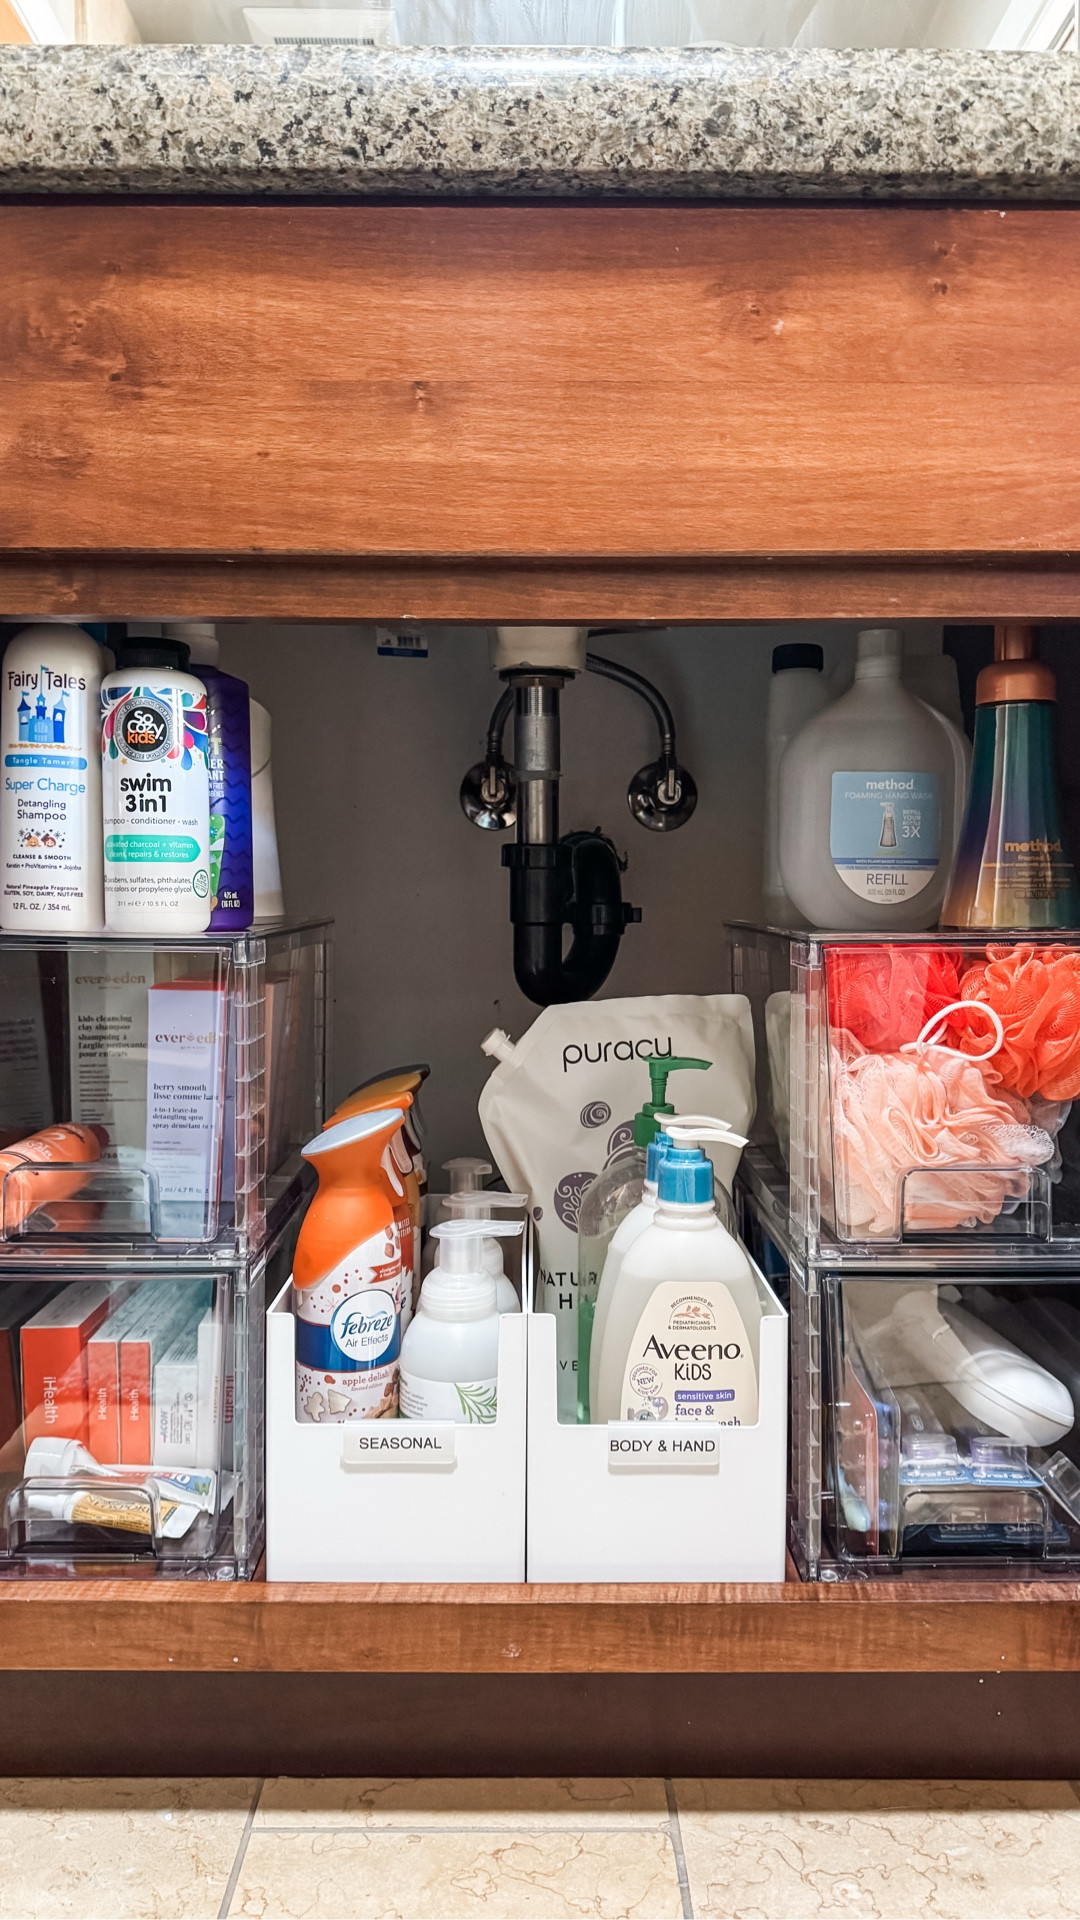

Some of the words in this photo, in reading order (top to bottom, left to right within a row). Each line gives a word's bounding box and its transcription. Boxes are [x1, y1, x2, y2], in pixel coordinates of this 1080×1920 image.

[7, 671, 38, 691] Fairy
[45, 671, 87, 691] Tales
[127, 728, 156, 744] kids
[12, 757, 38, 765] Tangle
[5, 777, 34, 795] Super
[37, 778, 86, 796] Charge
[120, 772, 172, 792] swim
[865, 778, 914, 790] method
[844, 791, 883, 800] FOAMING
[885, 791, 909, 800] HAND
[17, 798, 67, 810] Detangling
[16, 809, 67, 822] Shampoo
[130, 816, 176, 825] conditioner
[182, 818, 199, 826] wash
[902, 825, 921, 838] 3X
[130, 840, 160, 848] charcoal
[169, 841, 194, 849] vitamin
[128, 850, 153, 859] repairs
[160, 851, 189, 859] restores
[63, 864, 82, 872] Jojoba
[129, 875, 156, 884] sulfates,
[866, 873, 909, 886] REFILL
[22, 884, 49, 892] Pineapple
[138, 885, 173, 894] propylene
[174, 886, 192, 895] glycol
[12, 902, 20, 910] 12
[47, 903, 60, 911] 354
[61, 904, 71, 912] mL
[153, 1083, 175, 1092] berry
[177, 1083, 207, 1092] smooth
[152, 1113, 187, 1121] detangling
[670, 1295, 708, 1309] RECOMMENDED
[706, 1301, 714, 1309] BY
[340, 1312, 394, 1340] febreze
[345, 1338, 359, 1348] Air
[361, 1333, 389, 1347] Effects
[642, 1334, 741, 1361] Aveeno
[342, 1374, 367, 1387] apple
[636, 1375, 654, 1386] NEW
[43, 1376, 59, 1425] iHealth
[677, 1392, 714, 1401] sensitive
[715, 1391, 732, 1400] skin
[97, 1387, 107, 1420] iHealth
[129, 1388, 140, 1421] iHealth
[675, 1403, 702, 1416] face
[704, 1405, 715, 1416] &
[359, 1437, 442, 1450] SEASONAL
[610, 1440, 653, 1452] BODY
[657, 1440, 667, 1452] &
[672, 1440, 716, 1452] HAND
